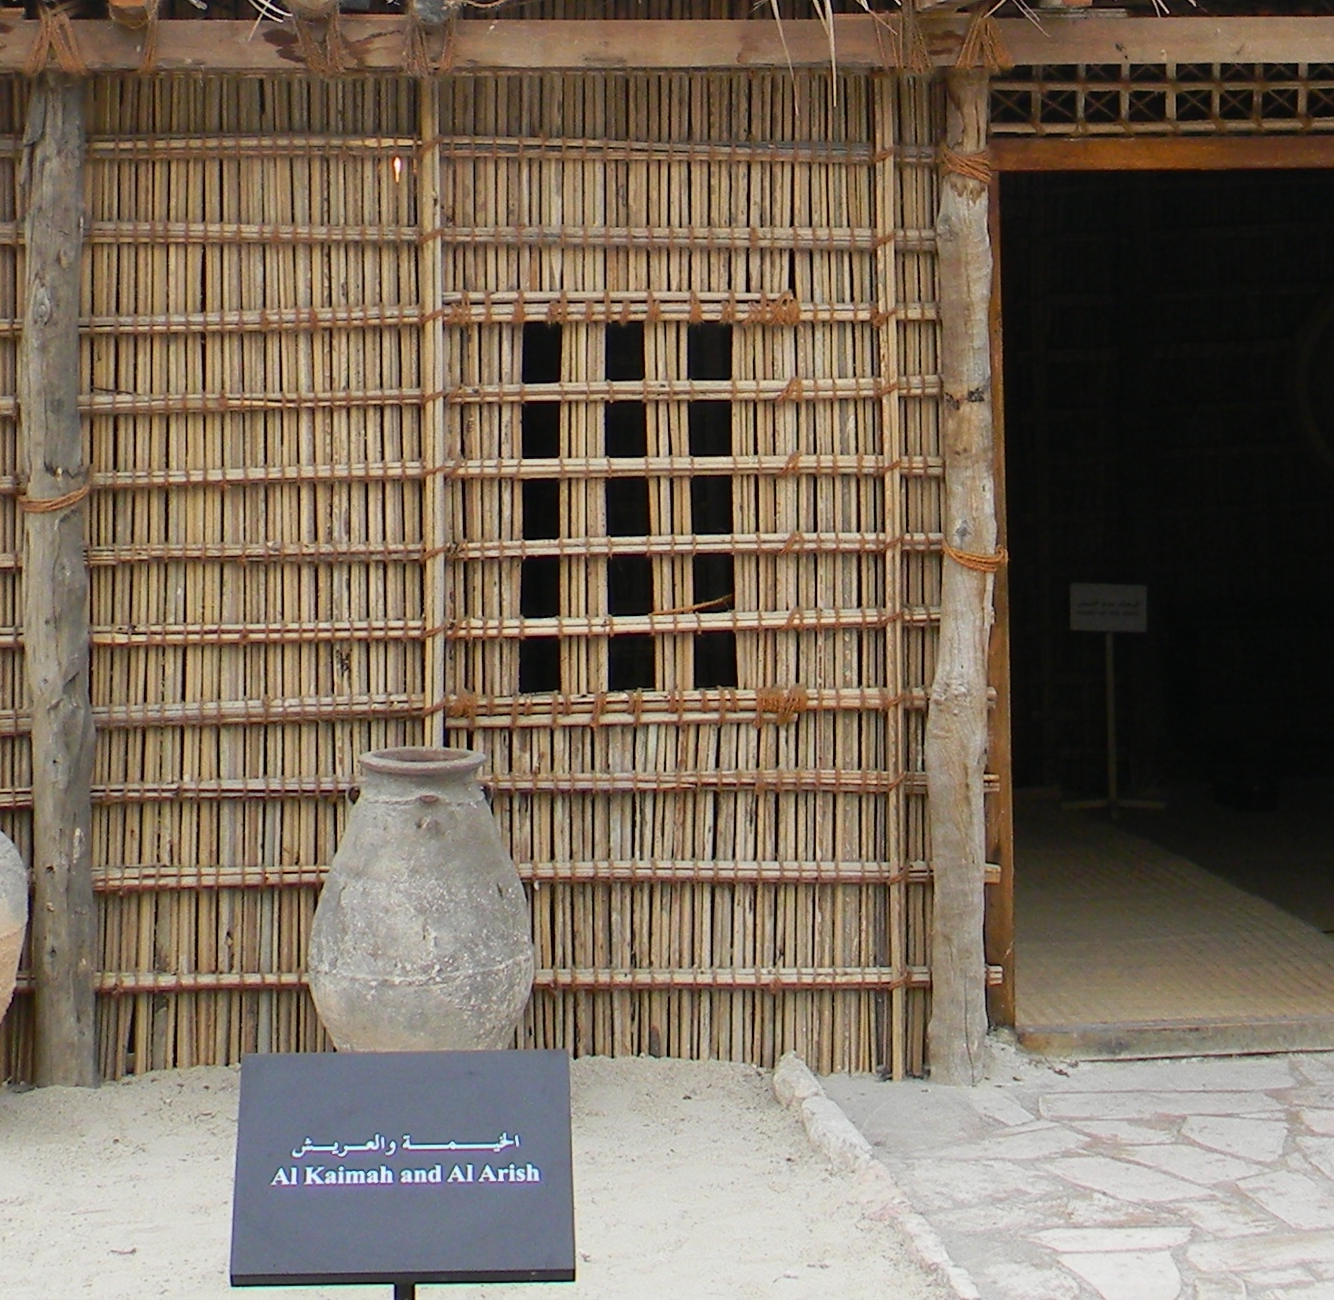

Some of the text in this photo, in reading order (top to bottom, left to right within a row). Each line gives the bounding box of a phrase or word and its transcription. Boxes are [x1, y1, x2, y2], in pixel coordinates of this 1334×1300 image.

[291, 1132, 520, 1158] الخيمة والعريش
[270, 1162, 541, 1186] Al Kaimah and Al Arish
